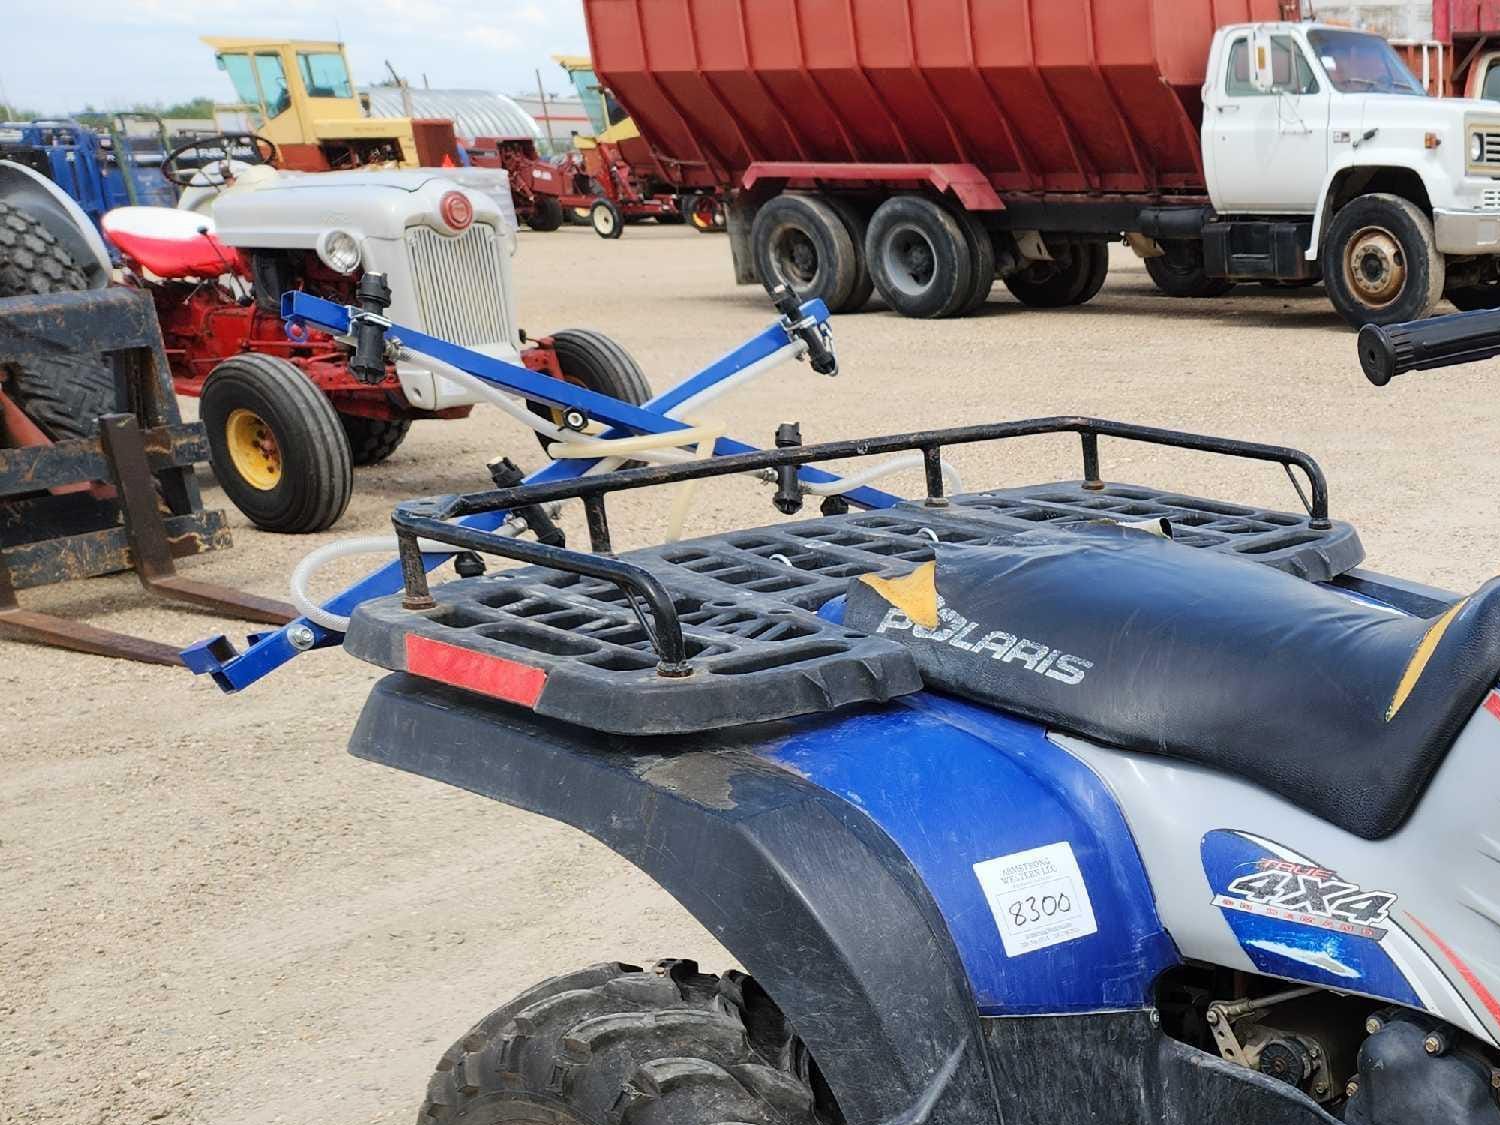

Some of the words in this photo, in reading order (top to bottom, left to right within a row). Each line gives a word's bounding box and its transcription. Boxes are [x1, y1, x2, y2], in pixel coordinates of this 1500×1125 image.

[877, 594, 1094, 685] POLARIS
[1258, 857, 1334, 881] TRUE
[1009, 892, 1071, 926] 8300
[1228, 869, 1398, 926] 4X4
